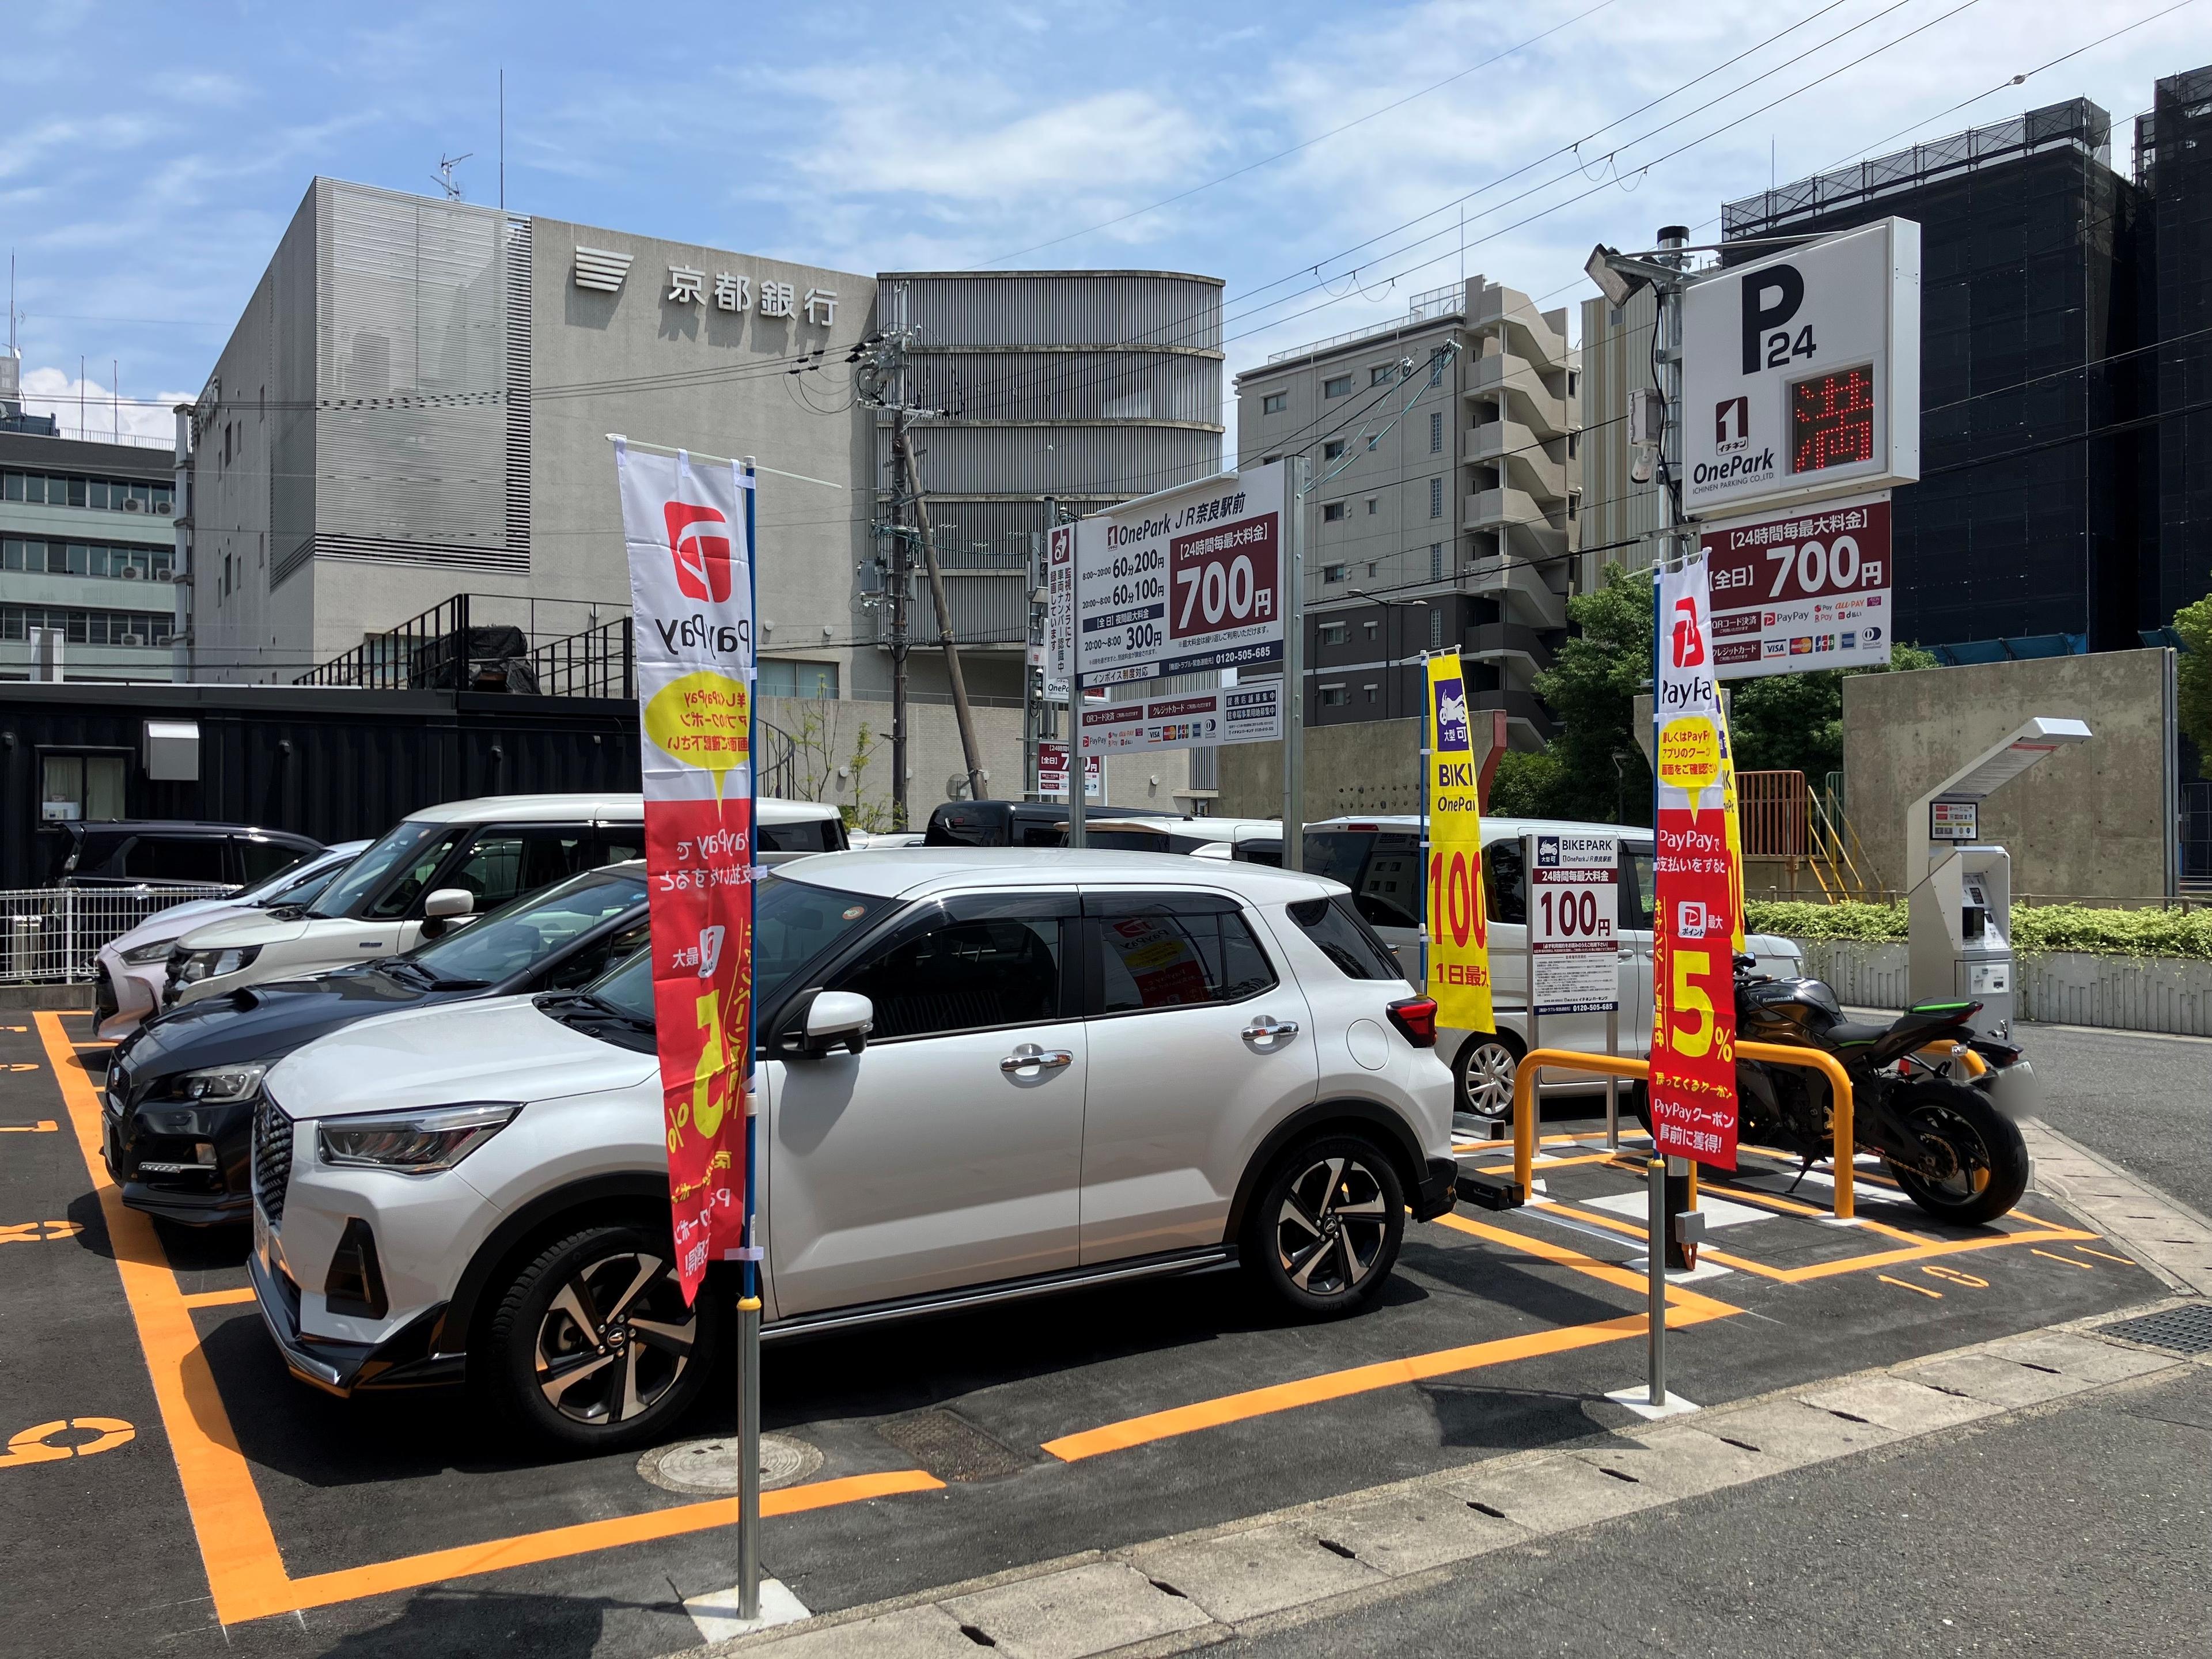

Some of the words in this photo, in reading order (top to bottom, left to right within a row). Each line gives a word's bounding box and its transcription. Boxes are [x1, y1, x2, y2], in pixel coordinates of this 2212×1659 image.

[668, 265, 839, 327] 京都銀行
[1741, 264, 1804, 376] P
[1767, 324, 1816, 369] 24
[1719, 440, 1746, 452] イチネン
[1694, 448, 1774, 484] OnePark
[1692, 484, 1718, 495] ICHINEN
[1721, 478, 1748, 489] PARKING
[1119, 513, 1171, 546] OnePark
[1175, 491, 1246, 529] JR奈良駅前
[1730, 509, 1867, 550] 【24時間毎最大料金】
[1180, 522, 1267, 560] 【24時間毎最大料金】
[1766, 535, 1882, 598] 700円
[1177, 555, 1271, 629] 700円
[1712, 615, 1756, 628] QRコード決済
[1777, 611, 1809, 623] PayPay
[1126, 623, 1162, 650] 300円
[1216, 646, 1270, 664] 0120-505-685
[1713, 644, 1756, 657] クレジットカード
[1767, 644, 1784, 653] VISA
[1093, 666, 1148, 684] インボイス制度対応
[1086, 712, 1115, 723] QRコード決済
[1153, 703, 1185, 715] クレジットカード
[1090, 736, 1107, 746] PayPay
[1562, 840, 1585, 850] BIKE
[1586, 840, 1612, 850] PARK
[1541, 870, 1609, 882] 24時間毎最大料金
[1430, 851, 1486, 949] 100
[1540, 891, 1610, 937] 100円
[1707, 914, 1724, 930] 最大
[1682, 927, 1705, 937] ポイント
[1573, 1003, 1613, 1012] 0120-505-685
